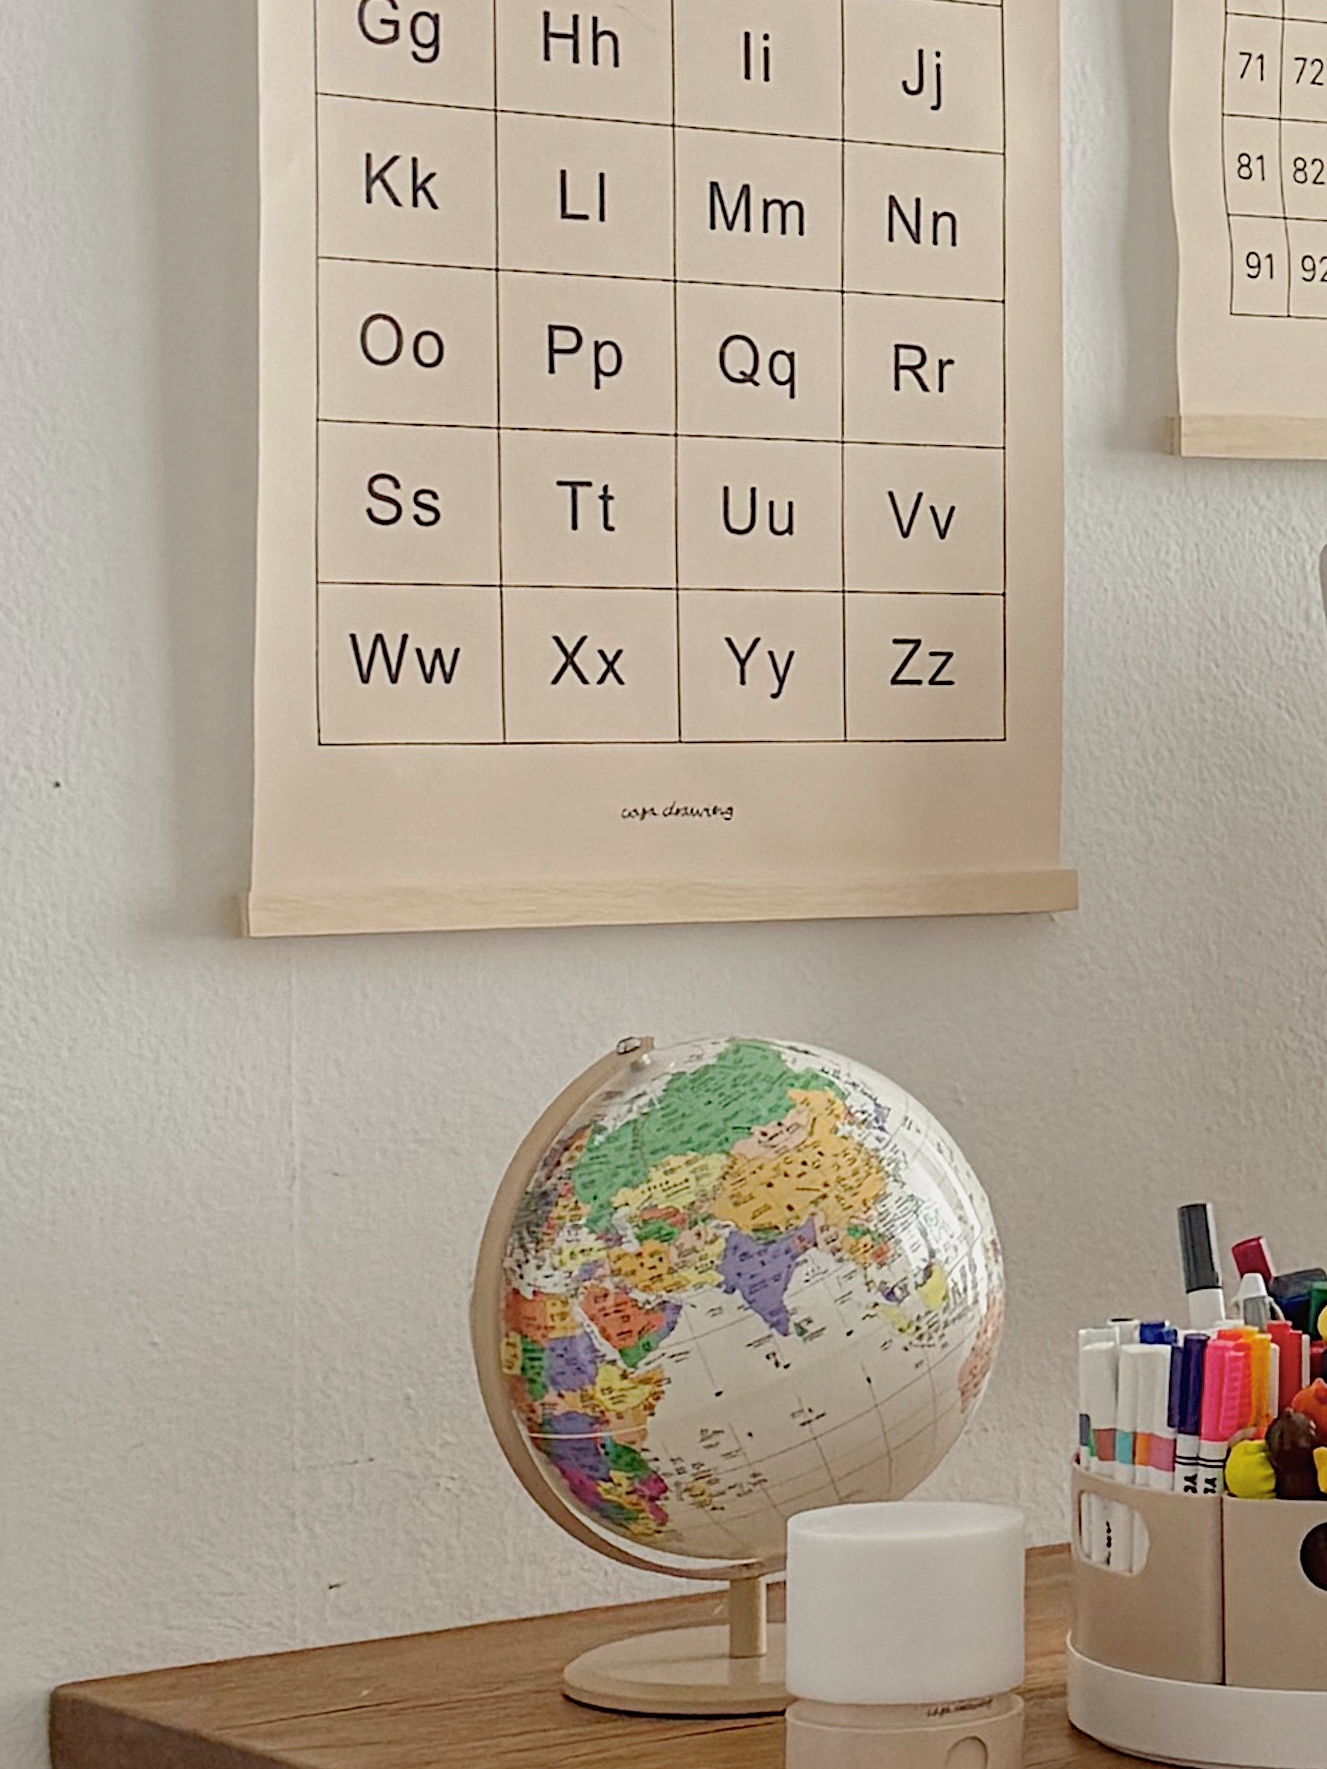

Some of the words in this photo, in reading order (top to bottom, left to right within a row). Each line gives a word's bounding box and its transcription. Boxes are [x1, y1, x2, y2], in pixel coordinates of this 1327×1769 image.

[542, 9, 620, 69] Hh
[901, 47, 943, 112] Jj
[1238, 51, 1265, 83] 71
[1293, 56, 1325, 87] 72
[364, 151, 440, 211] Kk
[708, 180, 805, 237] Mm
[887, 194, 958, 248] Nn
[1245, 250, 1274, 281] 91
[359, 312, 445, 369] Oo
[547, 323, 624, 391] Pp
[718, 333, 796, 400] Qq
[893, 343, 956, 394] Rr
[365, 472, 442, 528] Ss
[555, 479, 616, 533] Tt
[722, 485, 795, 537] Uu
[886, 490, 956, 541] Vv
[348, 632, 461, 685] Ww
[550, 634, 626, 686] Xx
[723, 636, 796, 700] Yy
[889, 637, 956, 686] Zz
